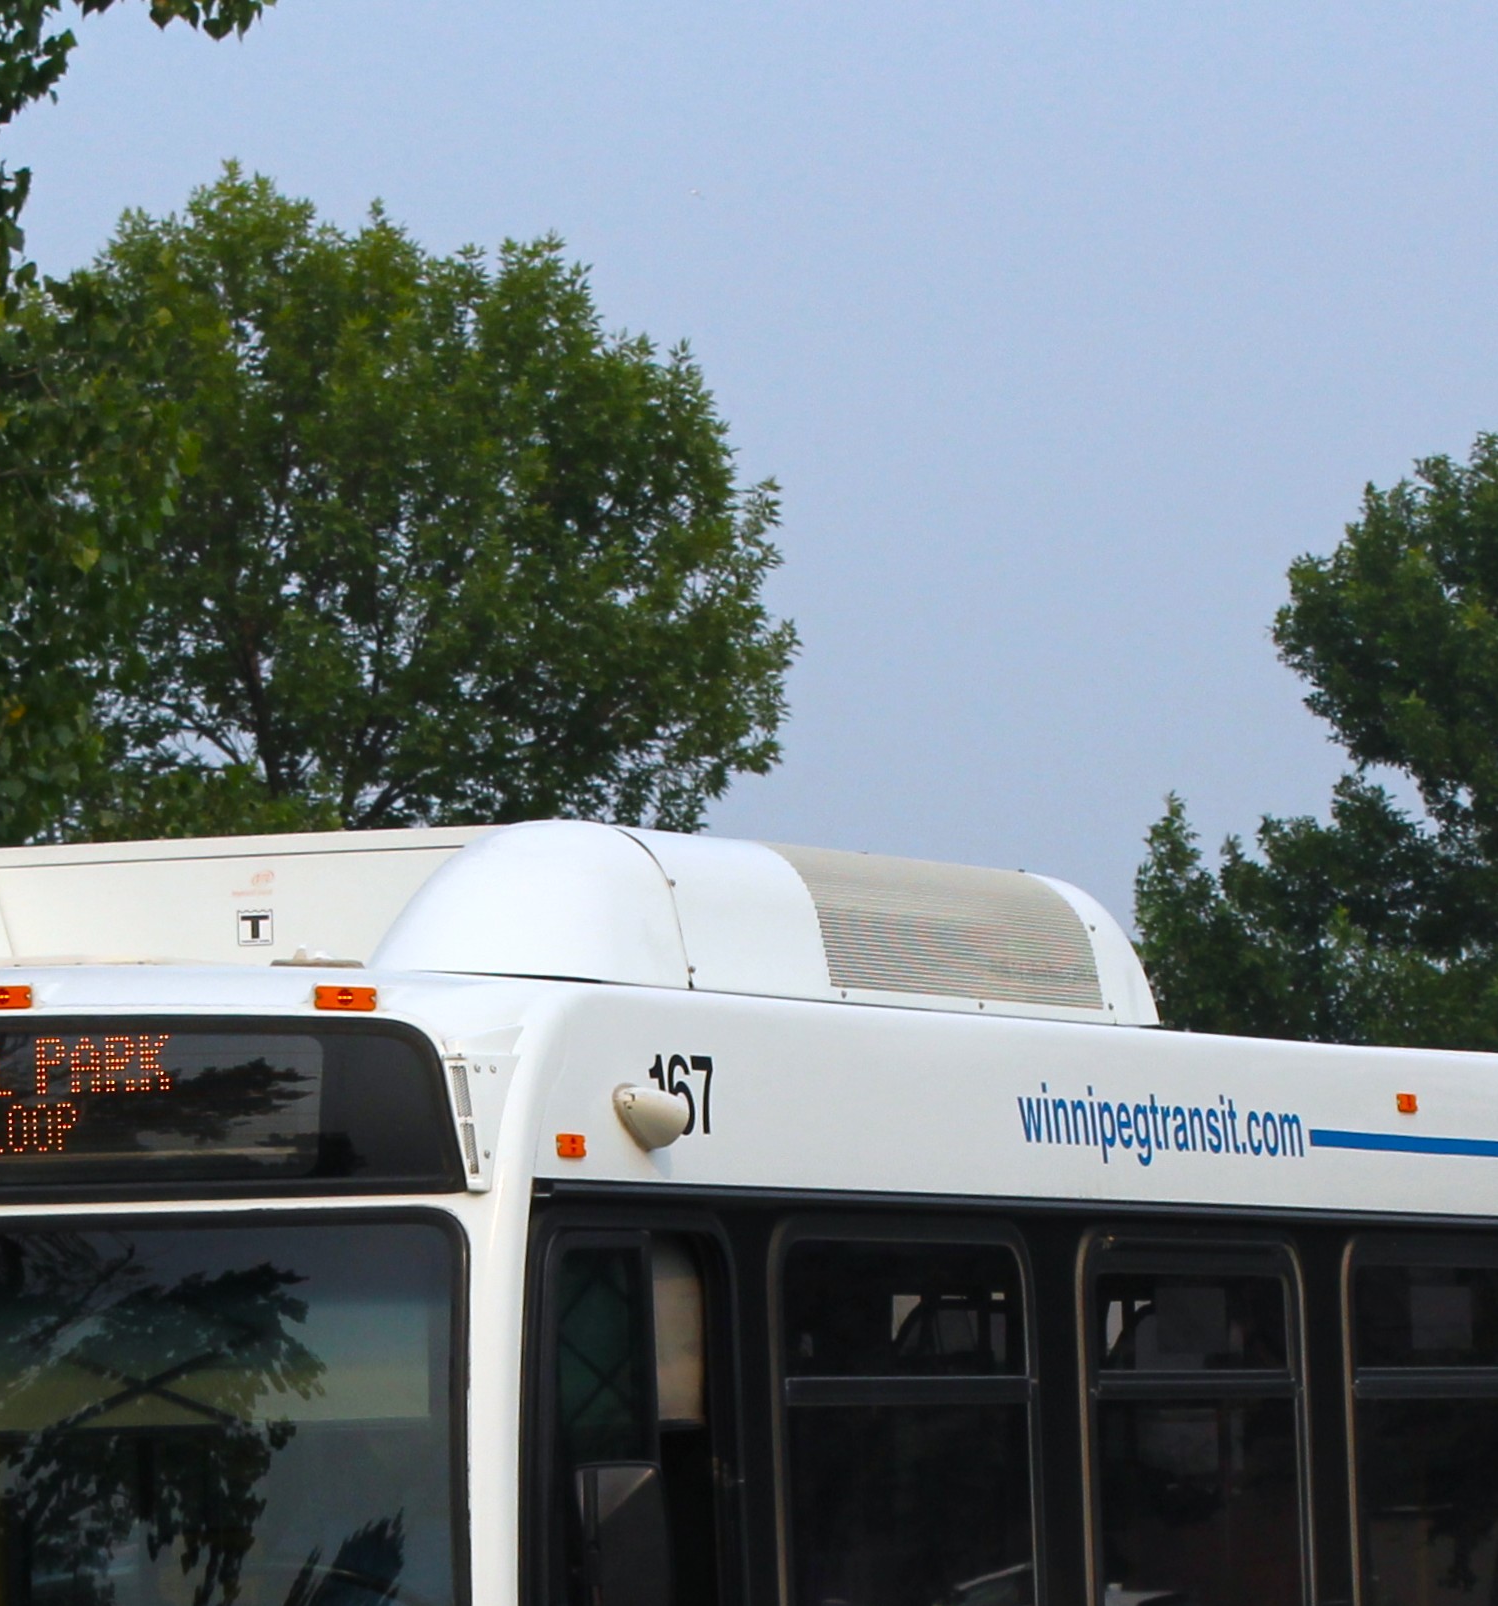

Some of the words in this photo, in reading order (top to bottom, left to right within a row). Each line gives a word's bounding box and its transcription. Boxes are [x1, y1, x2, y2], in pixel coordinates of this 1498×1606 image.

[240, 915, 270, 939] T
[35, 1034, 171, 1095] PARK
[1017, 1082, 1305, 1166] winnipegtransit.com
